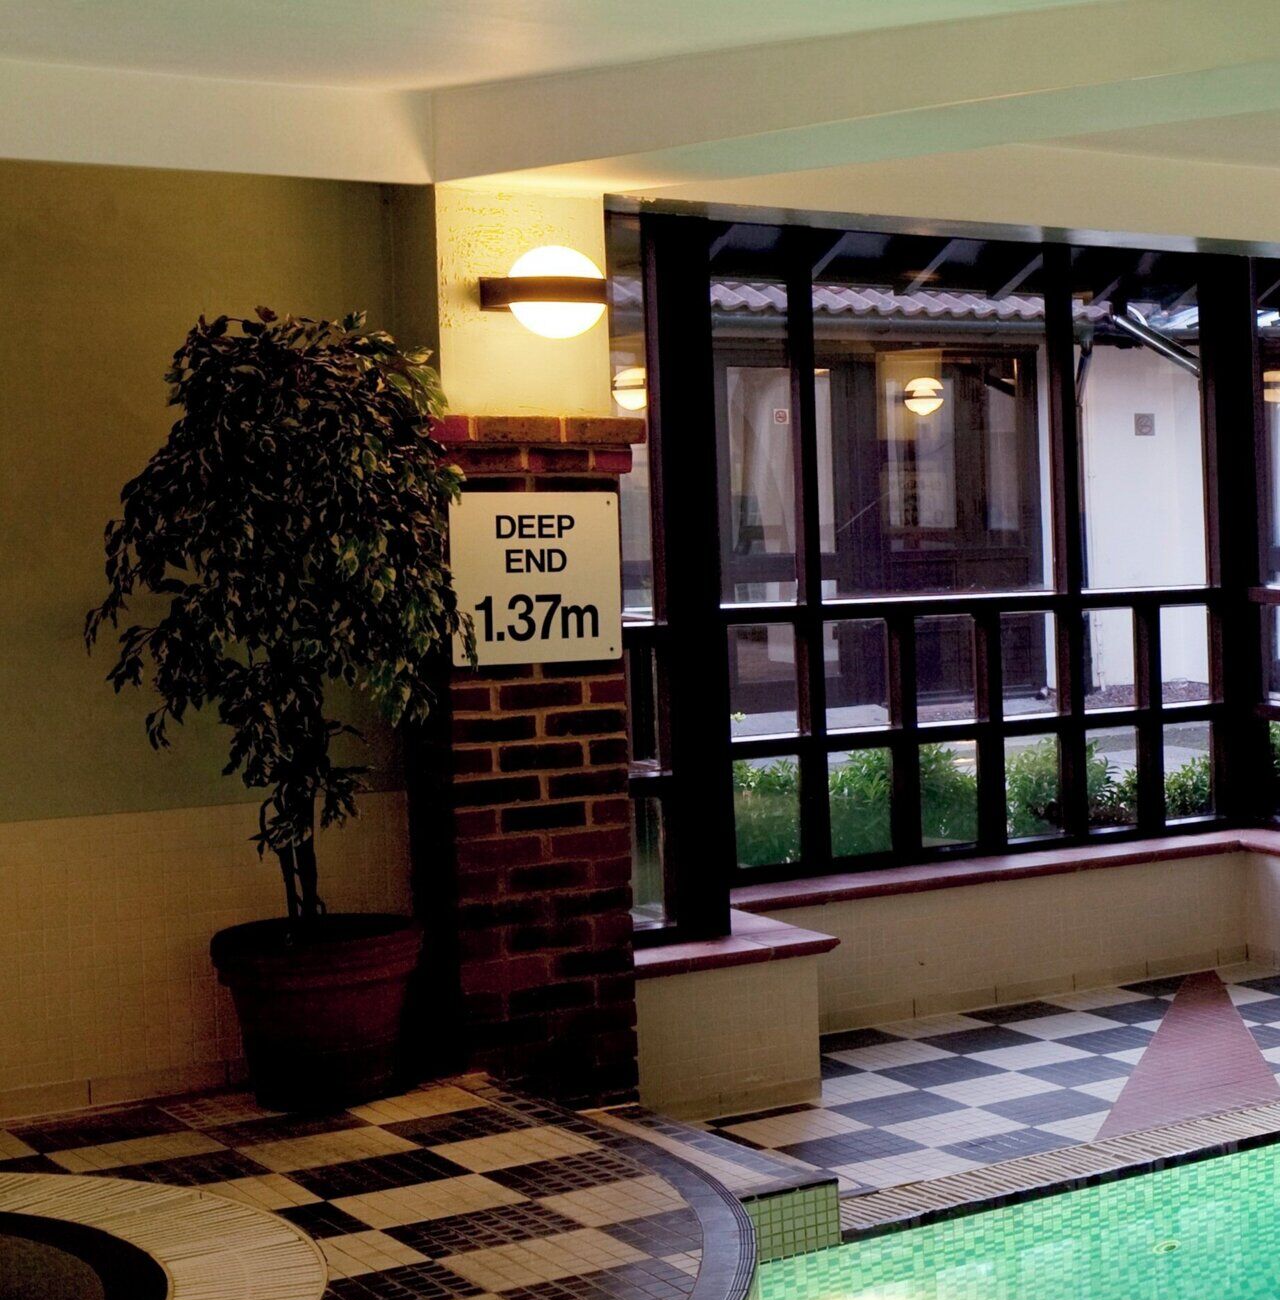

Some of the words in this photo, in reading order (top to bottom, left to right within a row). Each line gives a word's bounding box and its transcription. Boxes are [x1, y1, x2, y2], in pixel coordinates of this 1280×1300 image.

[495, 515, 575, 538] DEEP
[505, 549, 567, 573] END
[474, 594, 599, 642] 1.37m
